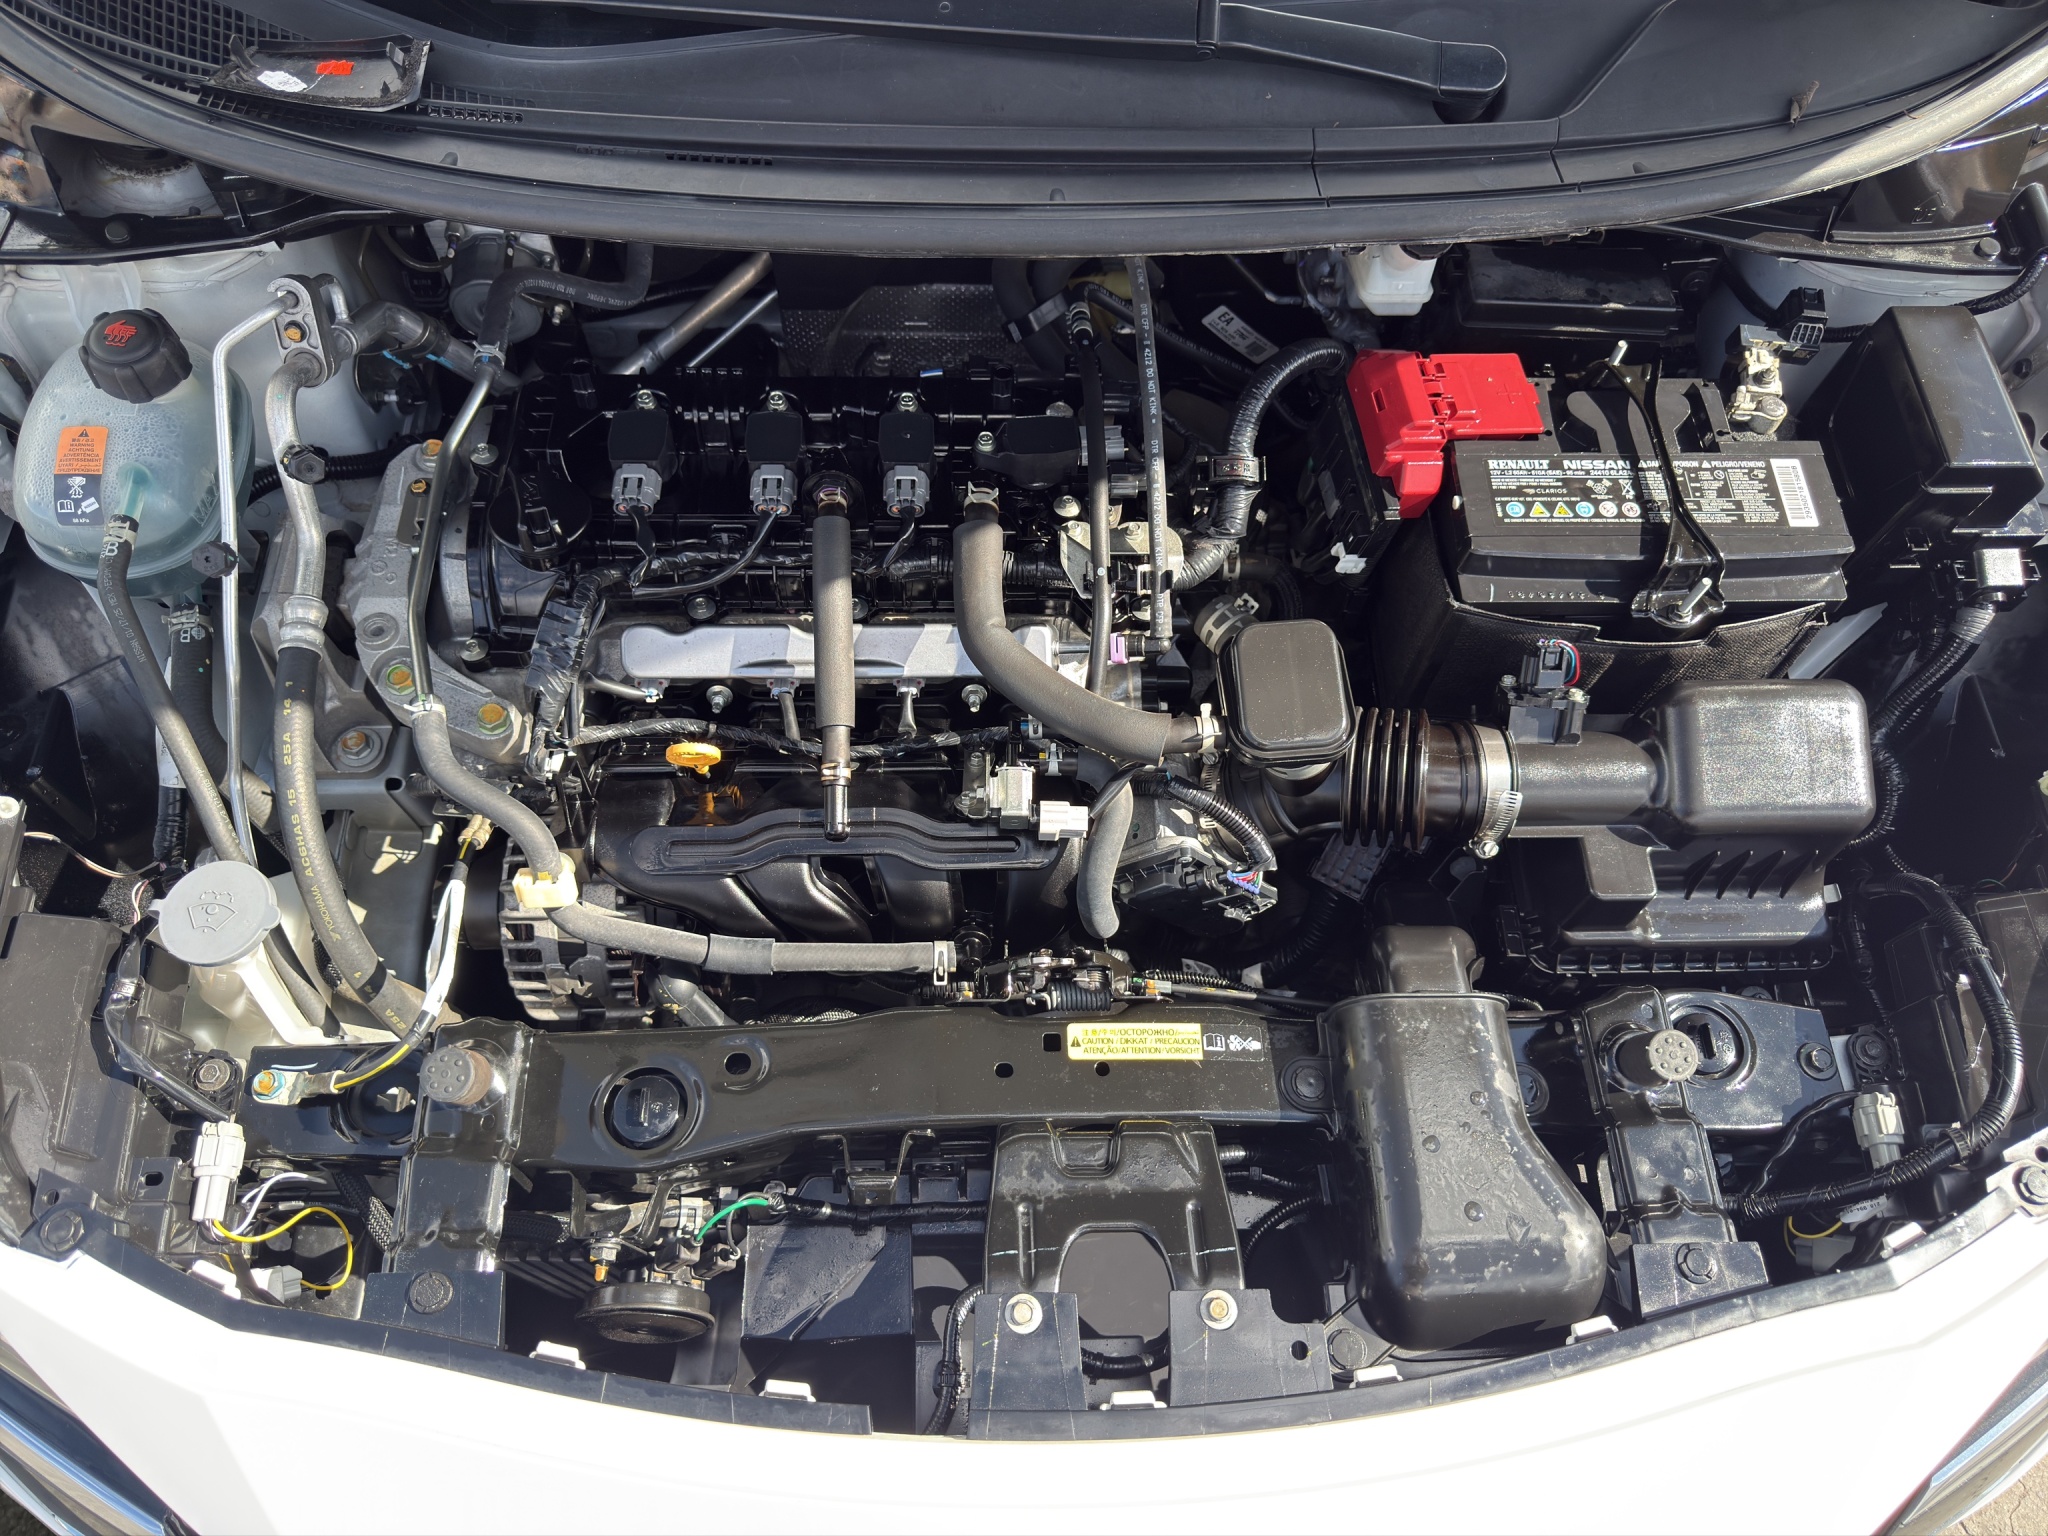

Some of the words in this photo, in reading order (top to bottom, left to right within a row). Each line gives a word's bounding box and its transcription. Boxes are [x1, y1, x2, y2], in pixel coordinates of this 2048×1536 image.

[1218, 311, 1235, 327] EA
[1148, 381, 1156, 394] NOT
[1149, 396, 1158, 416] KINK
[1487, 460, 1550, 469] RENAULT
[1562, 460, 1631, 469] NISSAN
[1152, 490, 1162, 510] 4212
[105, 541, 119, 556] B
[1155, 546, 1164, 567] KINK
[180, 628, 190, 642] B
[284, 732, 292, 765] 25A
[287, 788, 297, 807] 15
[311, 884, 336, 932] YOKOHAMA
[1082, 1037, 1114, 1045] CAUTION
[1120, 1037, 1147, 1045] DIKKAT
[1154, 1037, 1200, 1045] PRECAUCION
